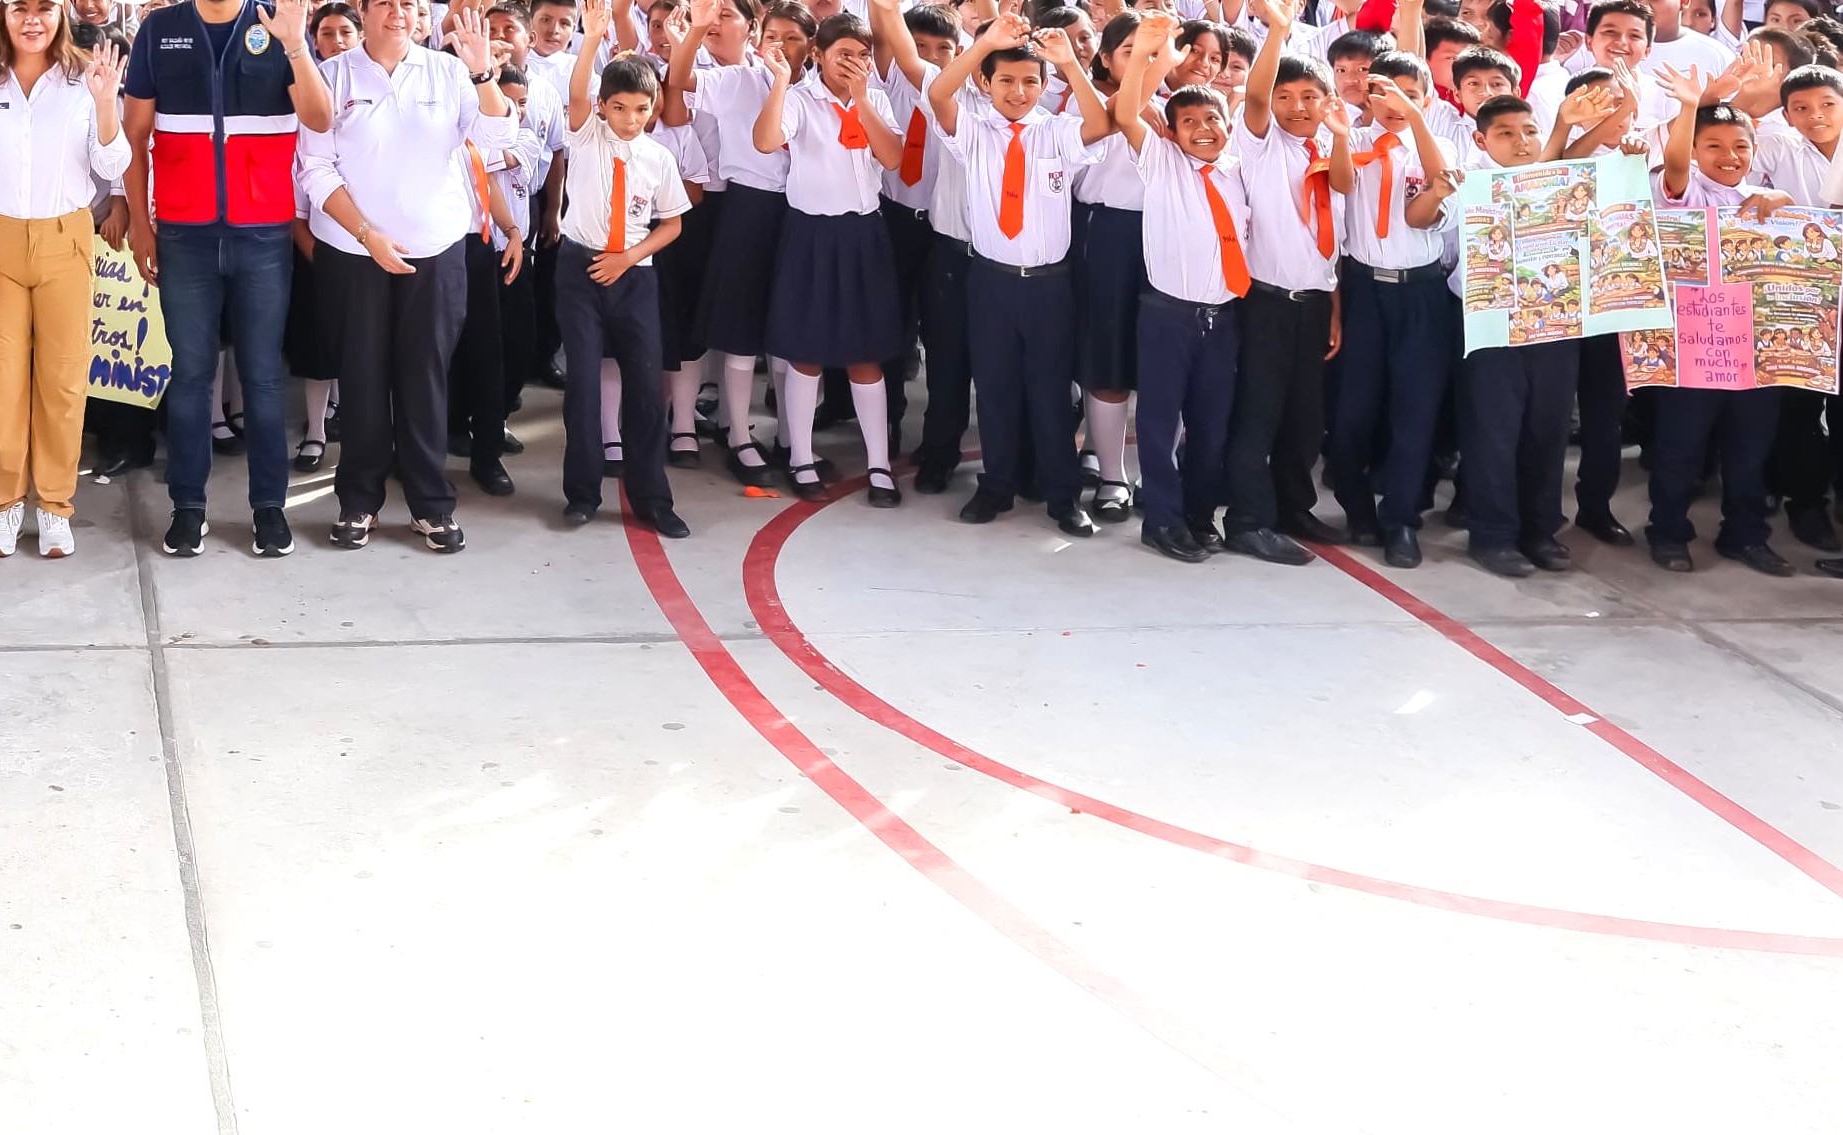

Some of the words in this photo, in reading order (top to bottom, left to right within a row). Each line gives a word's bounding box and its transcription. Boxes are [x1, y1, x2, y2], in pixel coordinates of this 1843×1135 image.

[116, 296, 148, 313] en
[1676, 297, 1747, 317] estudiantes
[1707, 318, 1726, 333] te
[1705, 347, 1731, 358] con
[1704, 370, 1739, 382] amor
